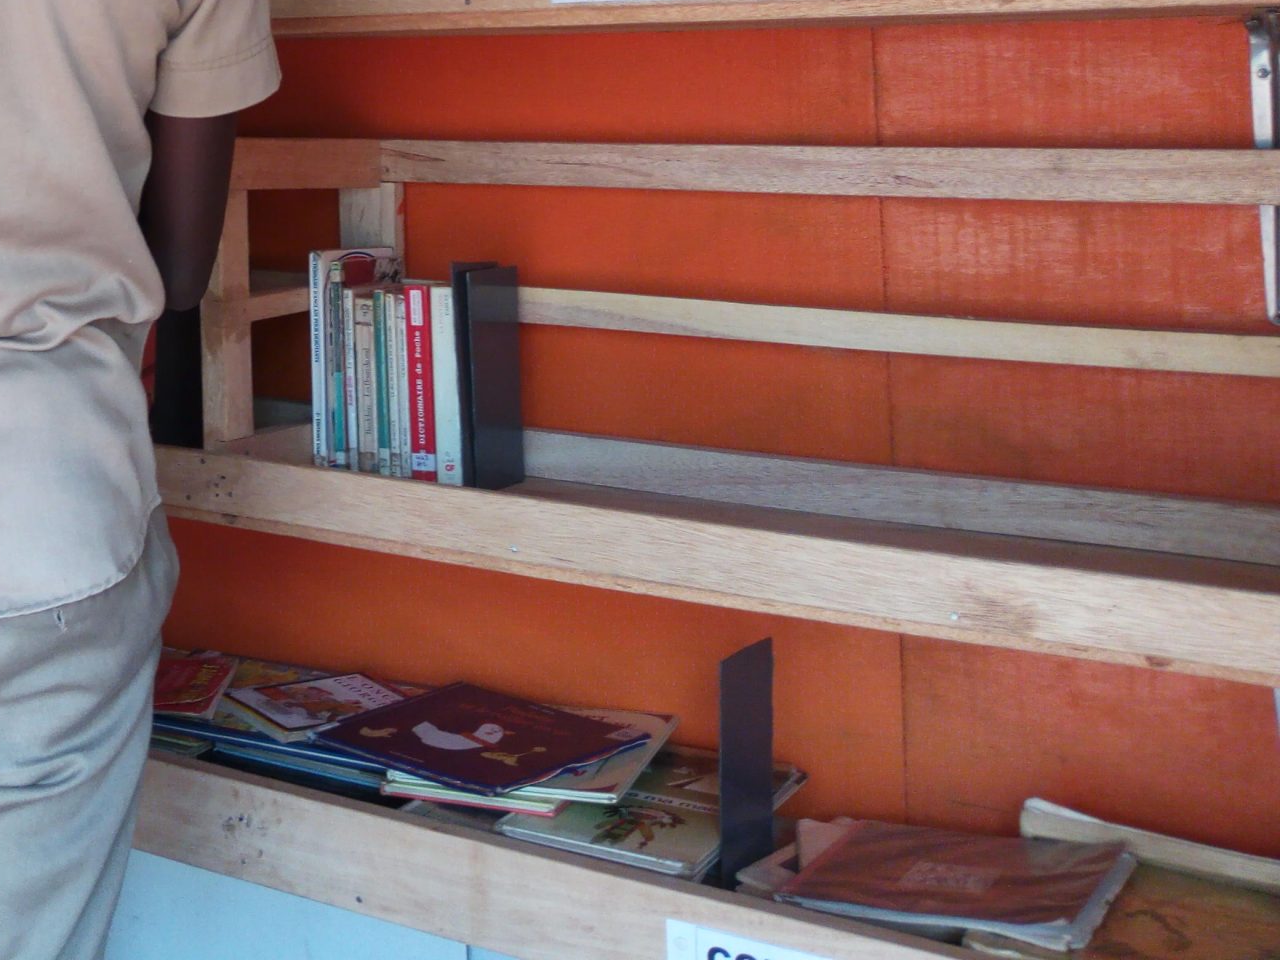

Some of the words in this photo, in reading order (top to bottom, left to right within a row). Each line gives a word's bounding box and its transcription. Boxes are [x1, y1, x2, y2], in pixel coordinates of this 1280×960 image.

[413, 330, 424, 359] Poche
[414, 362, 424, 374] de
[415, 378, 427, 445] DICTIONNAIRE
